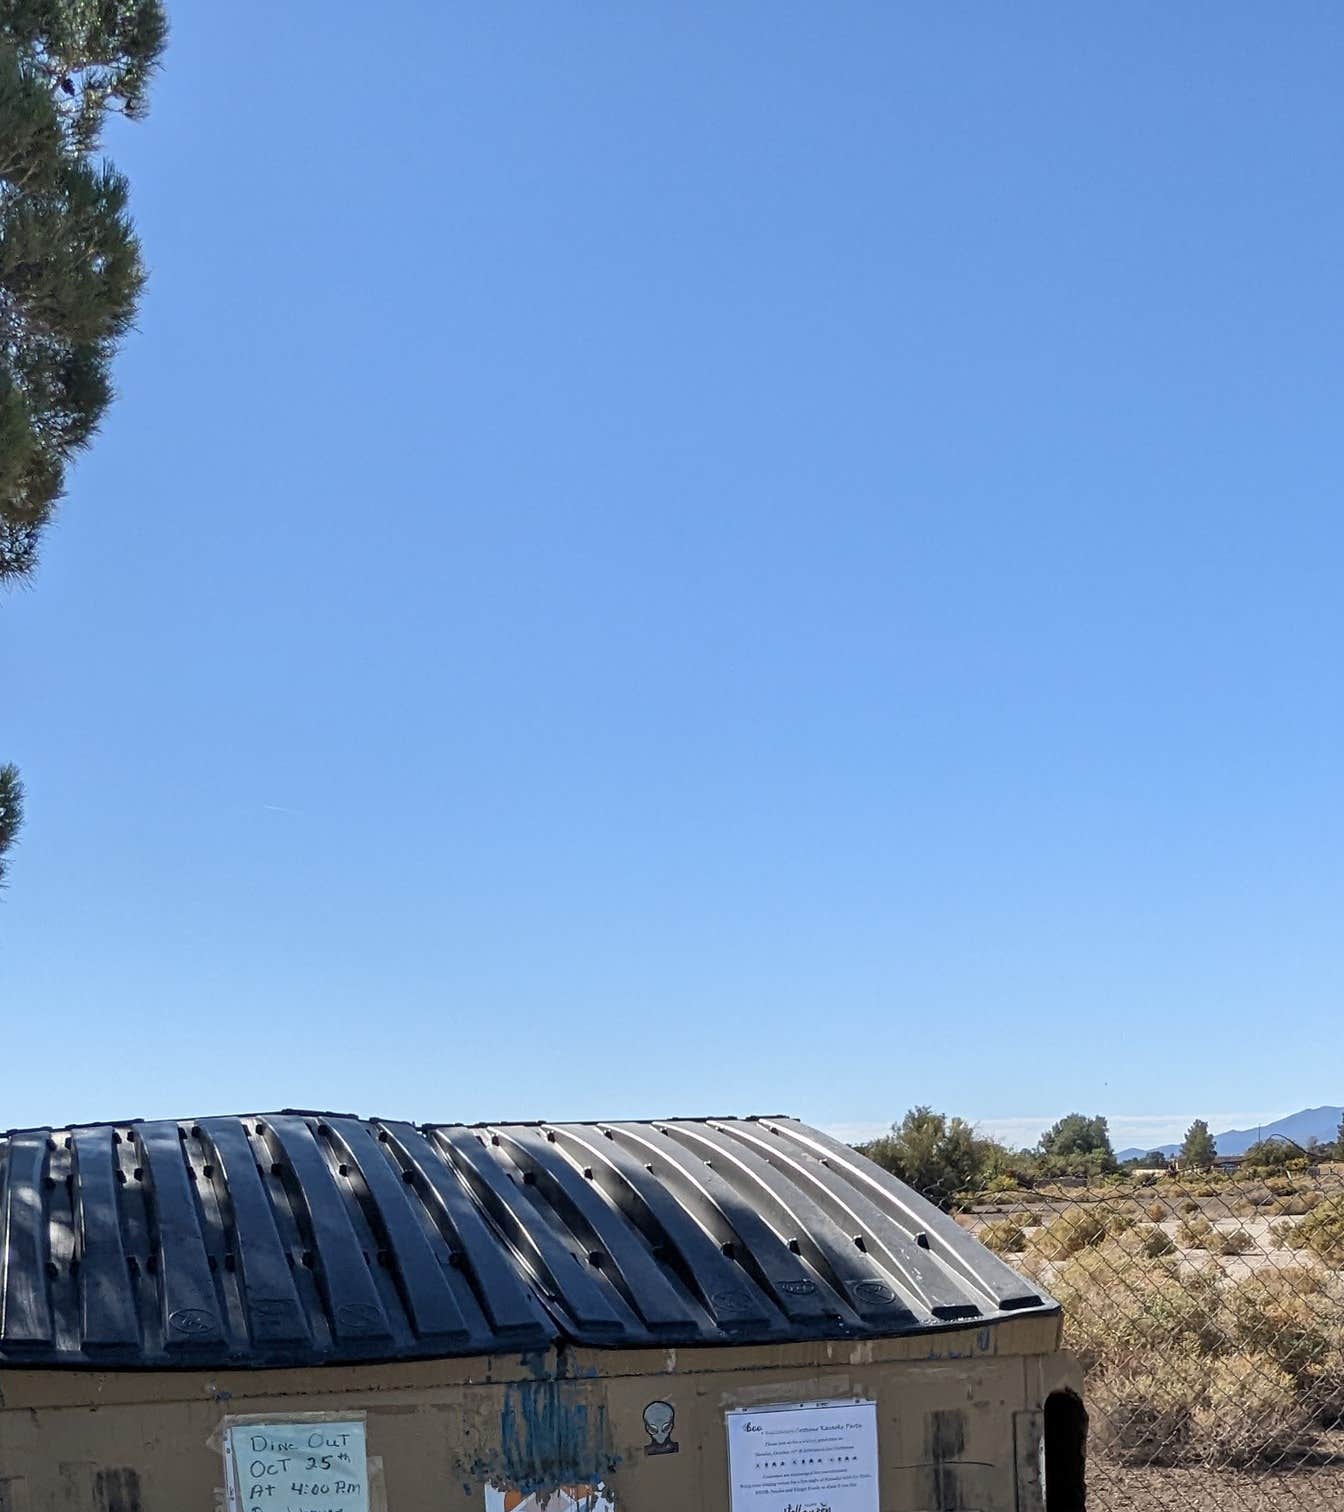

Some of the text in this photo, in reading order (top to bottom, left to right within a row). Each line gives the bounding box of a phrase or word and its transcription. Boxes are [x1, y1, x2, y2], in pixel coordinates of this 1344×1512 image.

[305, 1452, 351, 1470] 25th
[249, 1484, 275, 1499] At
[291, 1482, 330, 1495] 4:00
